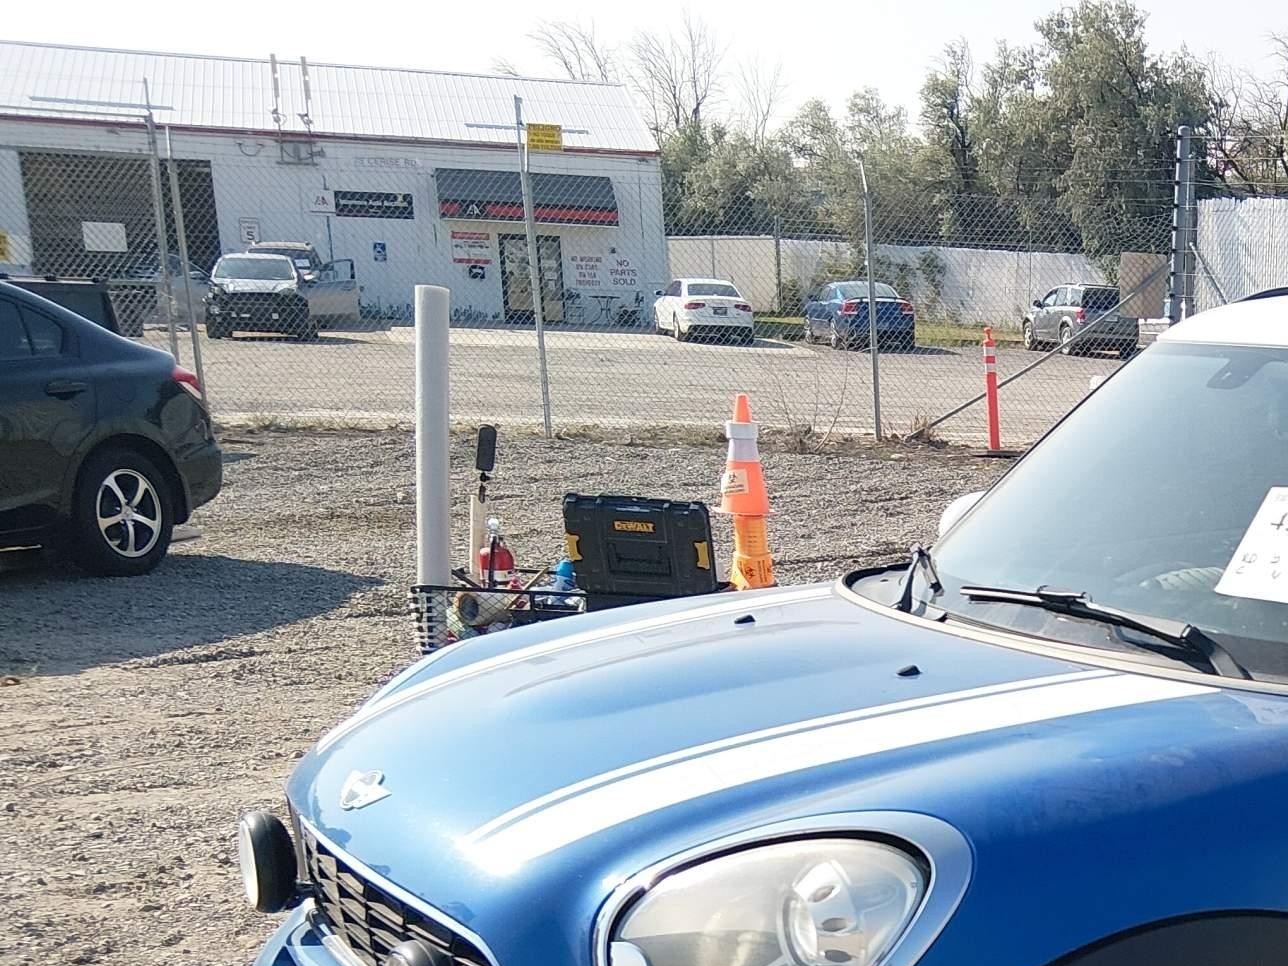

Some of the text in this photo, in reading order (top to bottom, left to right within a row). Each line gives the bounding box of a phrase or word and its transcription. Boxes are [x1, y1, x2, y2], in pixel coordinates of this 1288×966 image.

[616, 259, 629, 267] NO
[609, 268, 637, 277] PARTS
[612, 278, 637, 286] SOLD
